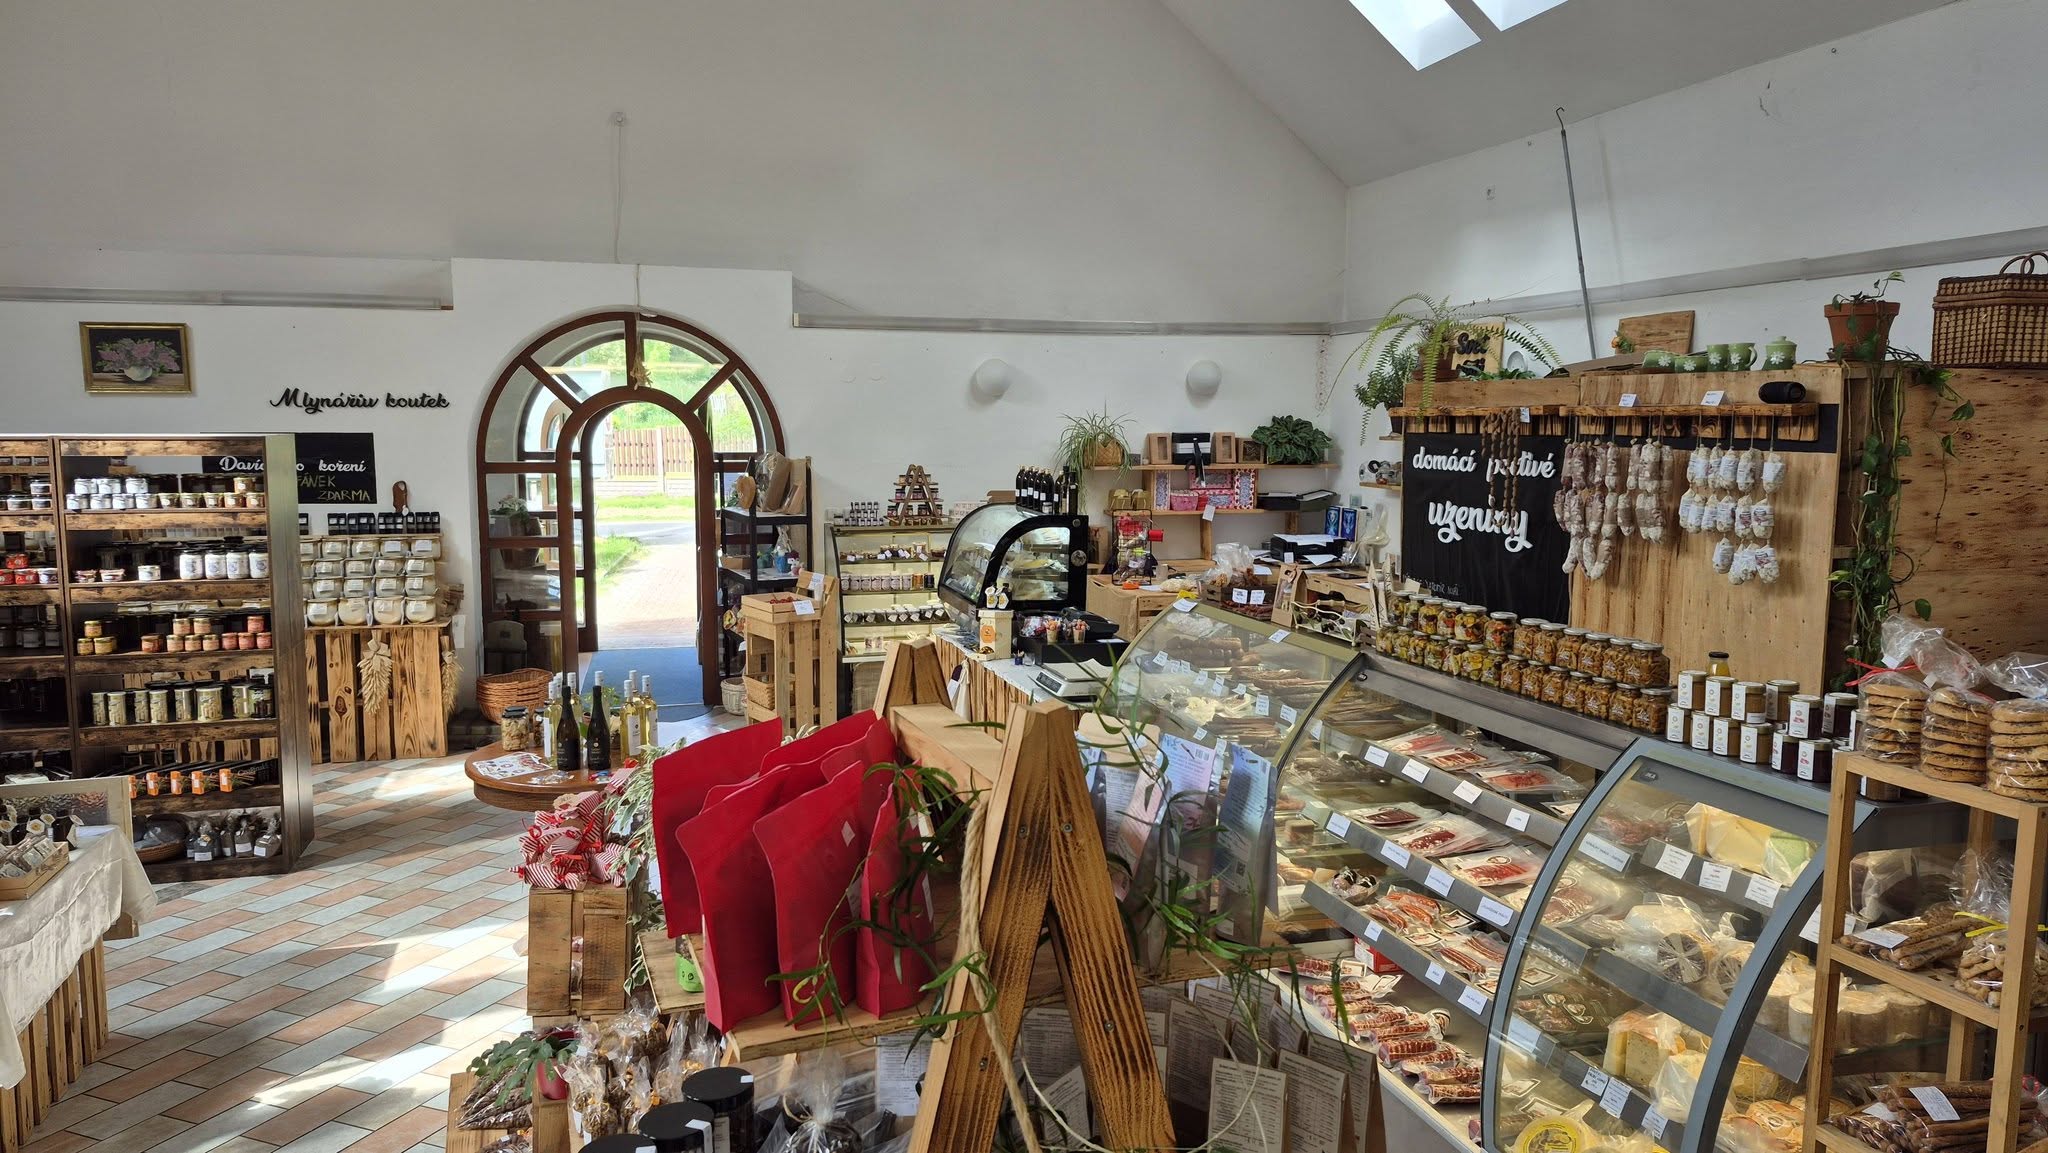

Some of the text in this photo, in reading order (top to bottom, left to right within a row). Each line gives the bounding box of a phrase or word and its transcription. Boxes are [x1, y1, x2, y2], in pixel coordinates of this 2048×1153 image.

[269, 388, 450, 414] Mlynářův koutek
[319, 459, 367, 472] koření
[1413, 446, 1478, 472] domácí
[319, 489, 371, 501] ZDARMA
[1428, 495, 1533, 553] uzeniny
